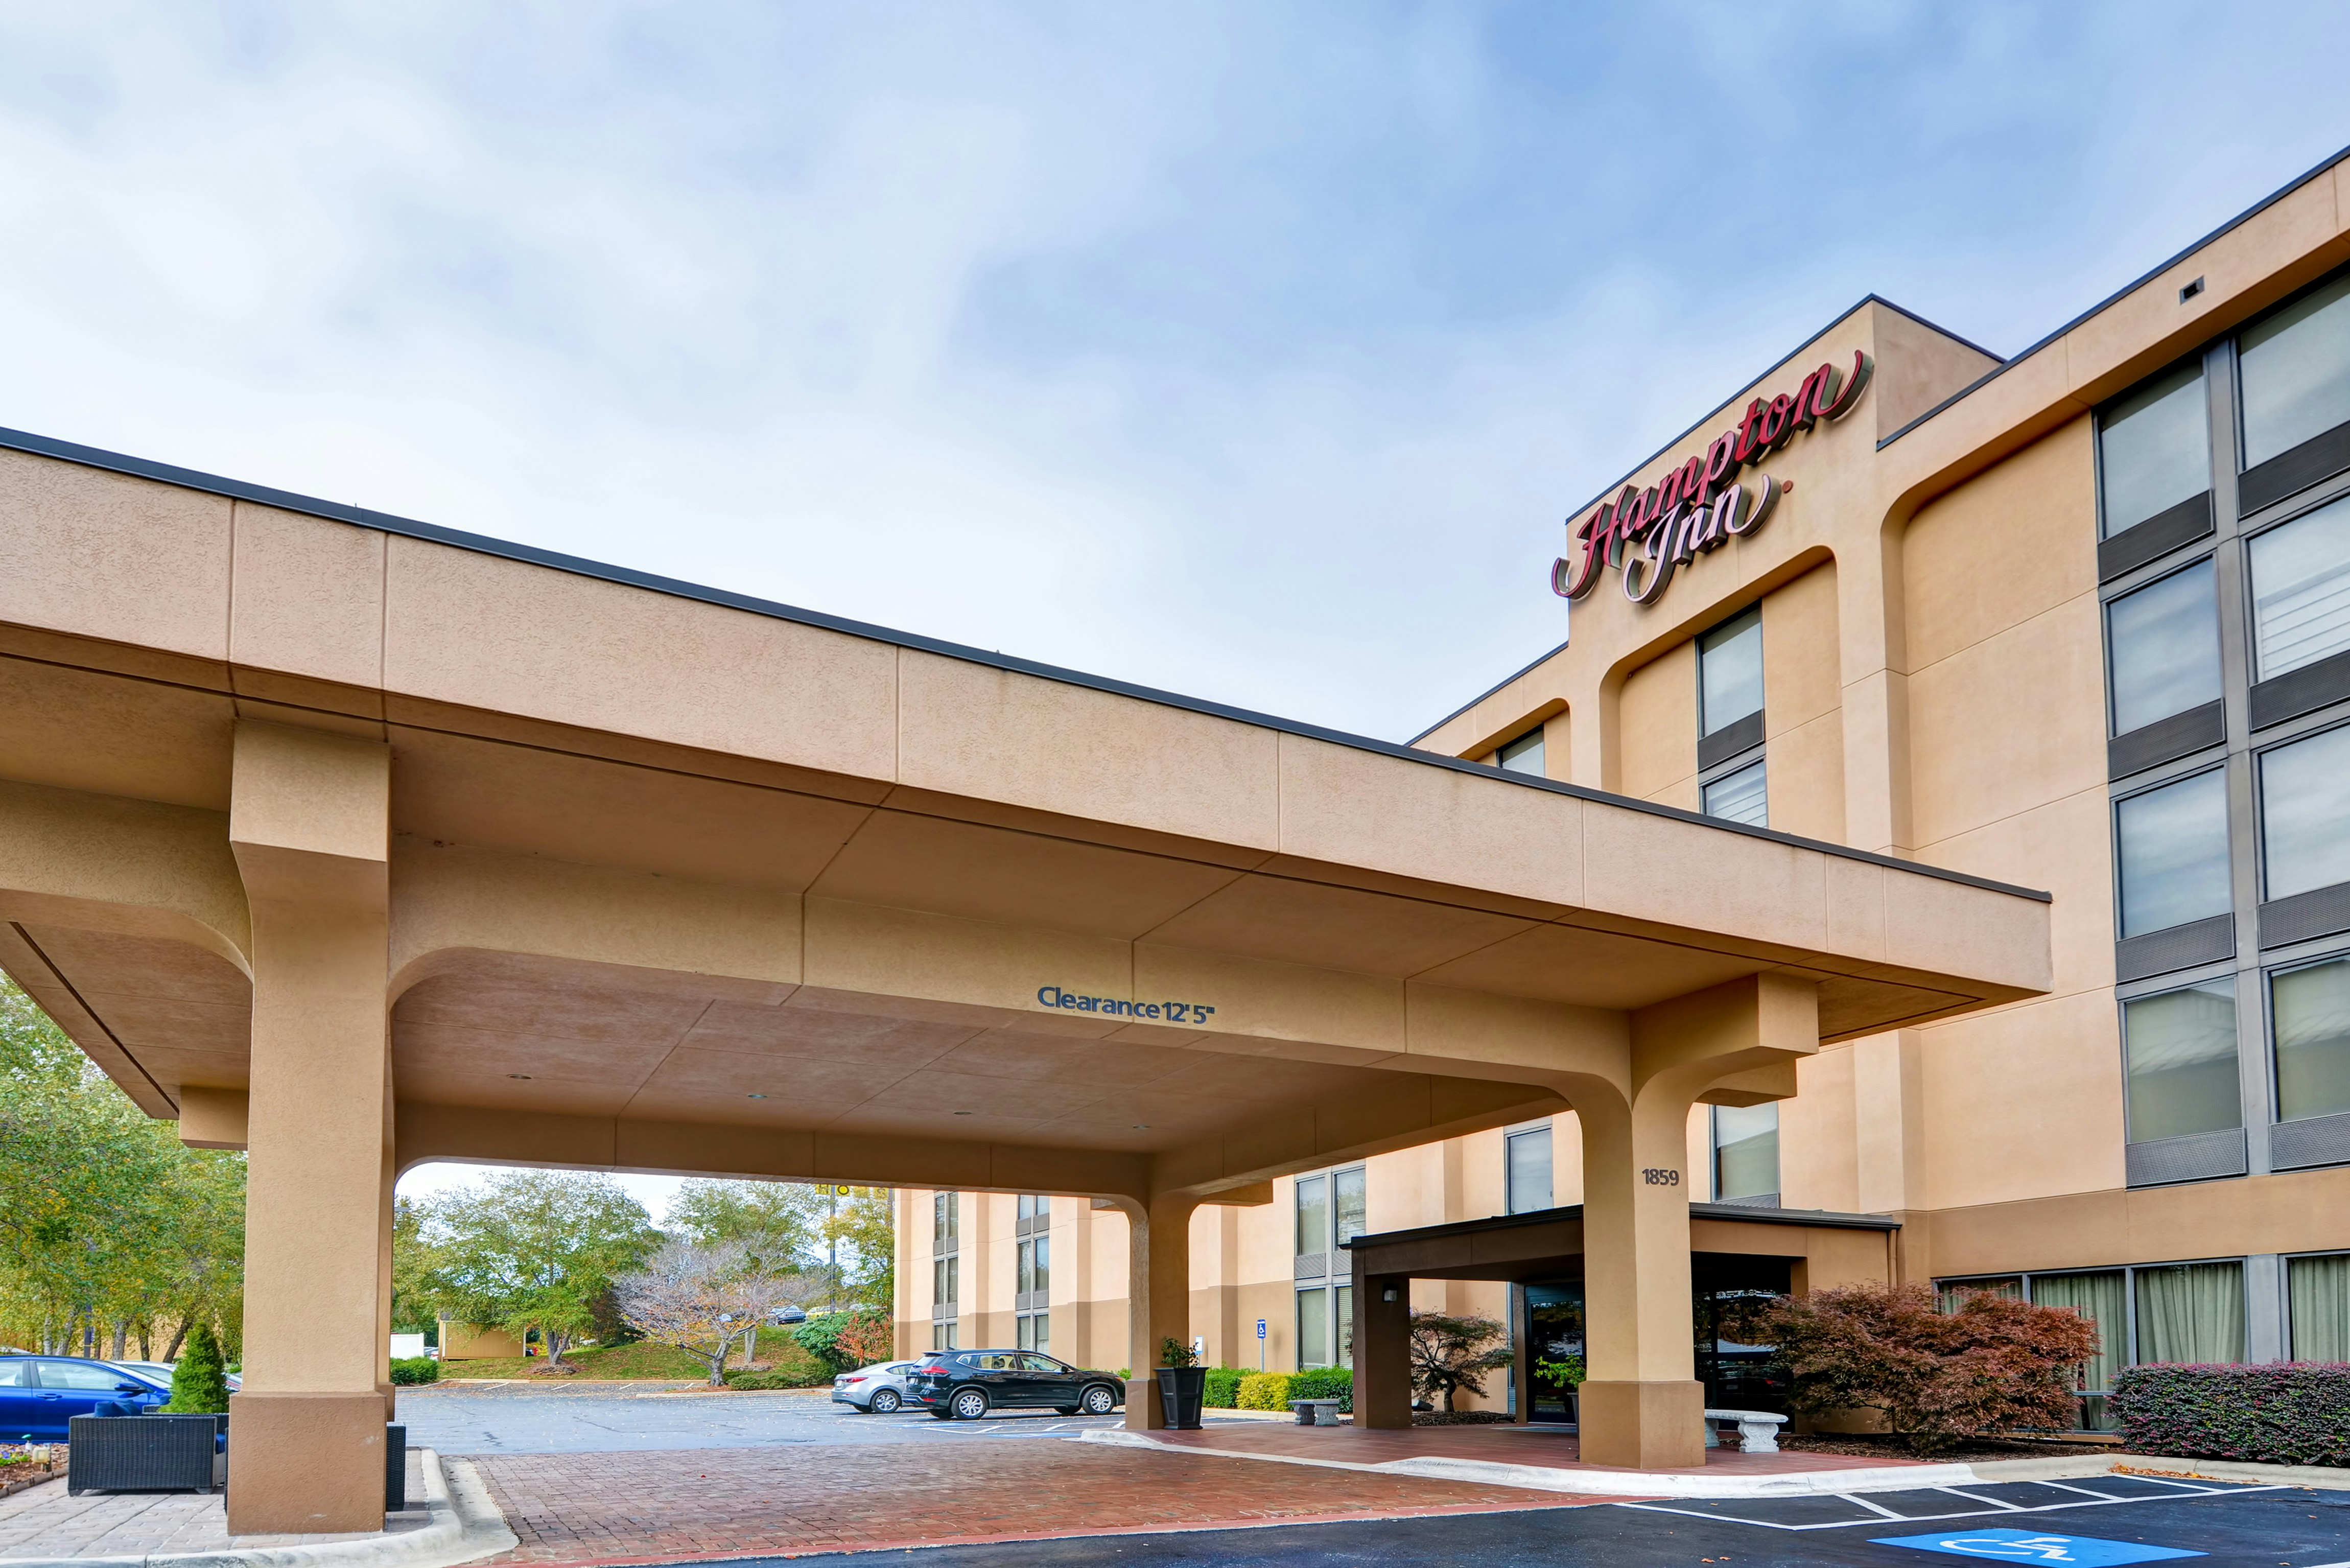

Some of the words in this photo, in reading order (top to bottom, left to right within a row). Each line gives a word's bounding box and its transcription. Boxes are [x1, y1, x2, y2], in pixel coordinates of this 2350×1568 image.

[1551, 349, 1874, 599] Hampton
[1621, 474, 1781, 604] Inn
[1038, 987, 1160, 1019] Clearance
[1642, 1168, 1679, 1186] 1859
